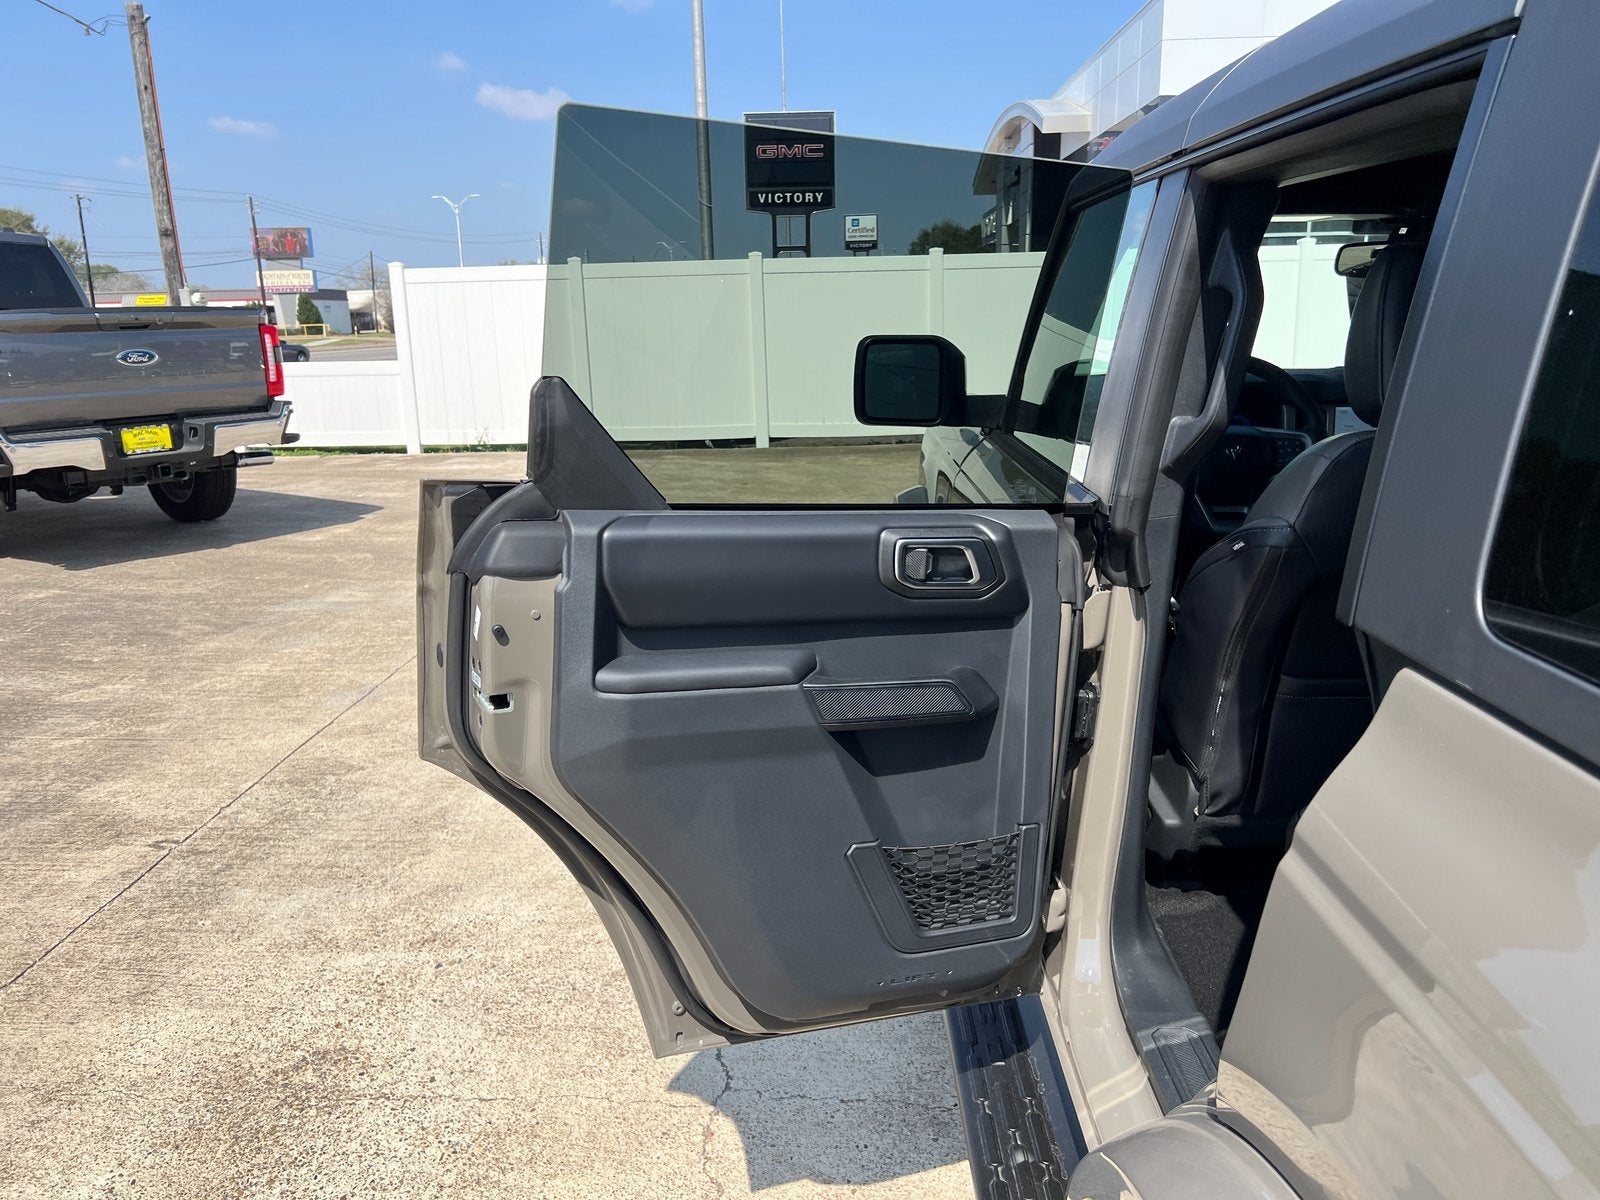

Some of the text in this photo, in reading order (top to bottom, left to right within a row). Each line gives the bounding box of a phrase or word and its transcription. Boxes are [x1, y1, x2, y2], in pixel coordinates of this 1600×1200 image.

[756, 144, 824, 158] GMC
[758, 192, 824, 203] VICTORY
[847, 226, 875, 234] Certified
[127, 352, 149, 362] Ford
[890, 971, 939, 985] LIFT
